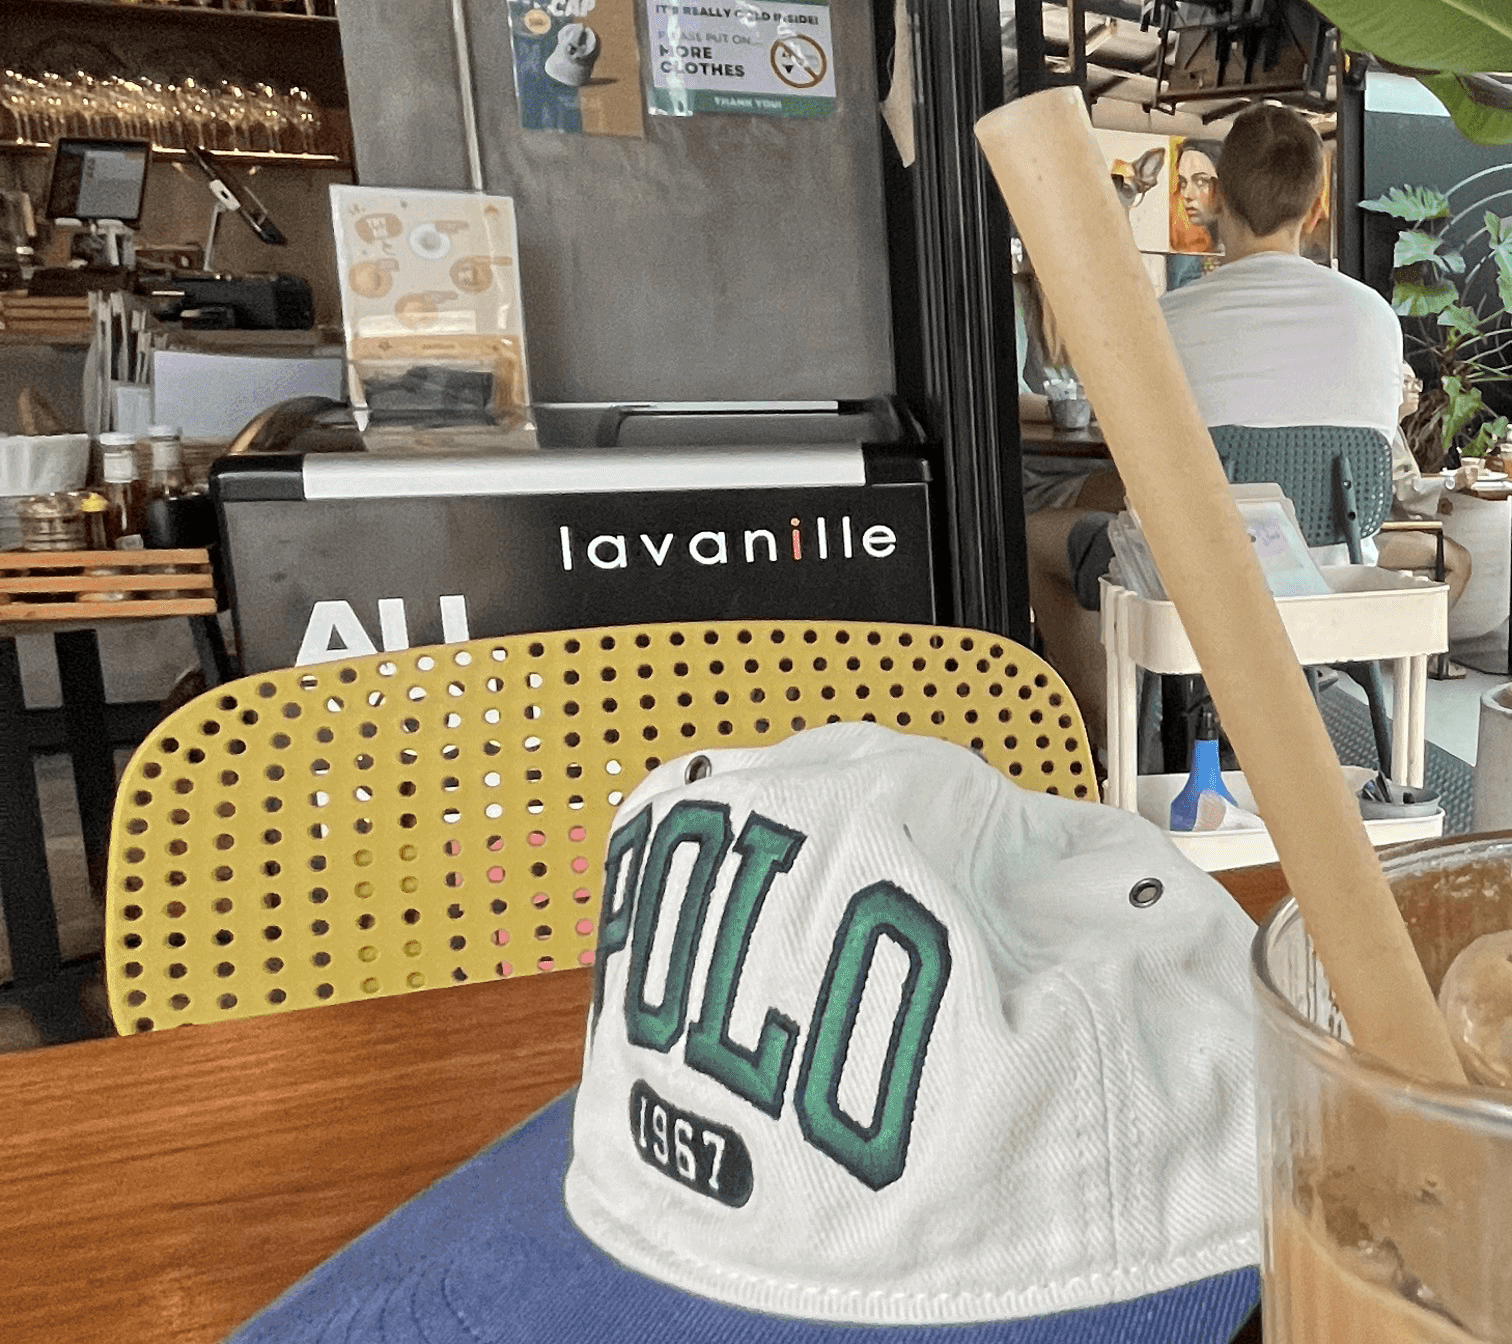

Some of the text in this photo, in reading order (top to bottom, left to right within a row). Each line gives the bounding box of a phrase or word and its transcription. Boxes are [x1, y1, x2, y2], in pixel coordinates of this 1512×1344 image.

[682, 6, 731, 19] REALLY
[658, 31, 702, 43] PASE
[705, 32, 728, 43] PUT
[659, 44, 713, 59] MORE
[660, 61, 746, 77] CLOTHES
[714, 96, 753, 108] THANK
[559, 515, 898, 571] lavanille
[593, 798, 952, 1192] POLO
[636, 1095, 726, 1192] 1967
